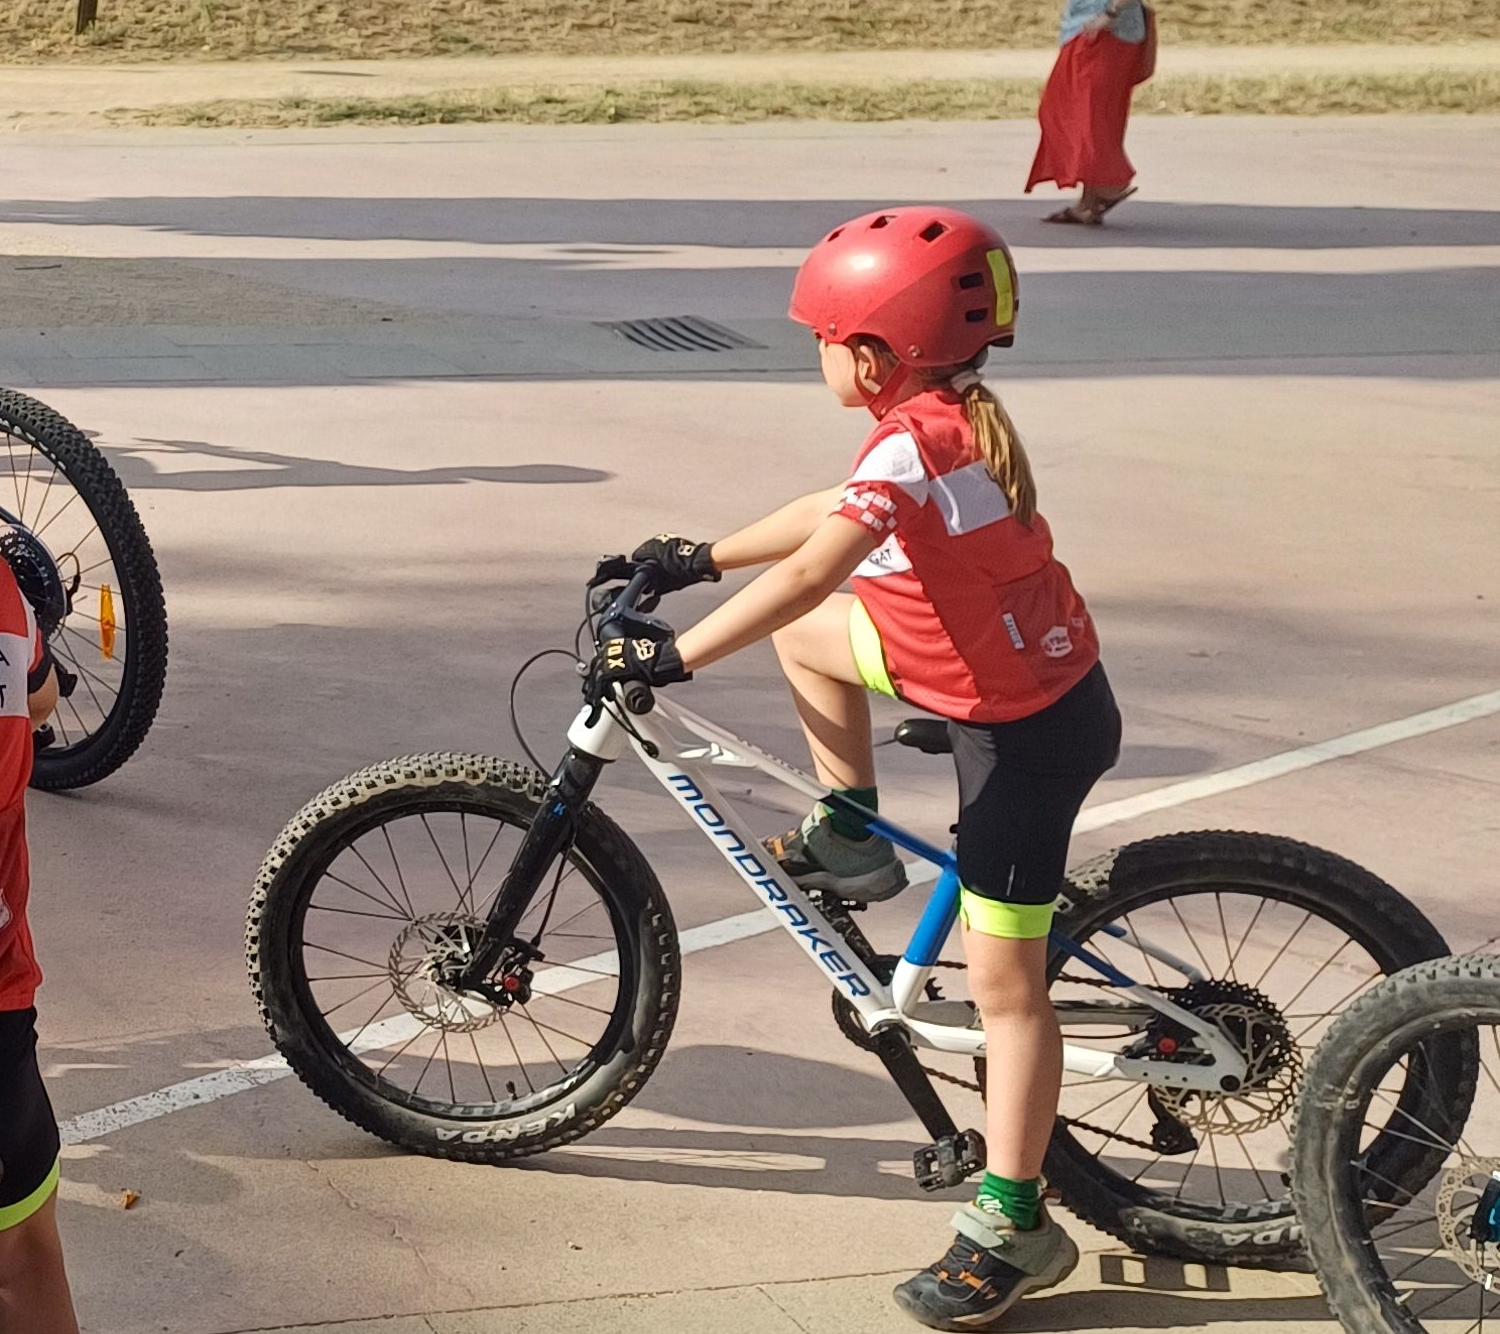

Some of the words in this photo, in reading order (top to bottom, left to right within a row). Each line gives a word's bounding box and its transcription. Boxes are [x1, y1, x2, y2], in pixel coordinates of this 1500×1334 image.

[607, 638, 626, 669] FOX
[668, 774, 872, 999] MONDRAKER
[436, 1102, 576, 1144] KENDA
